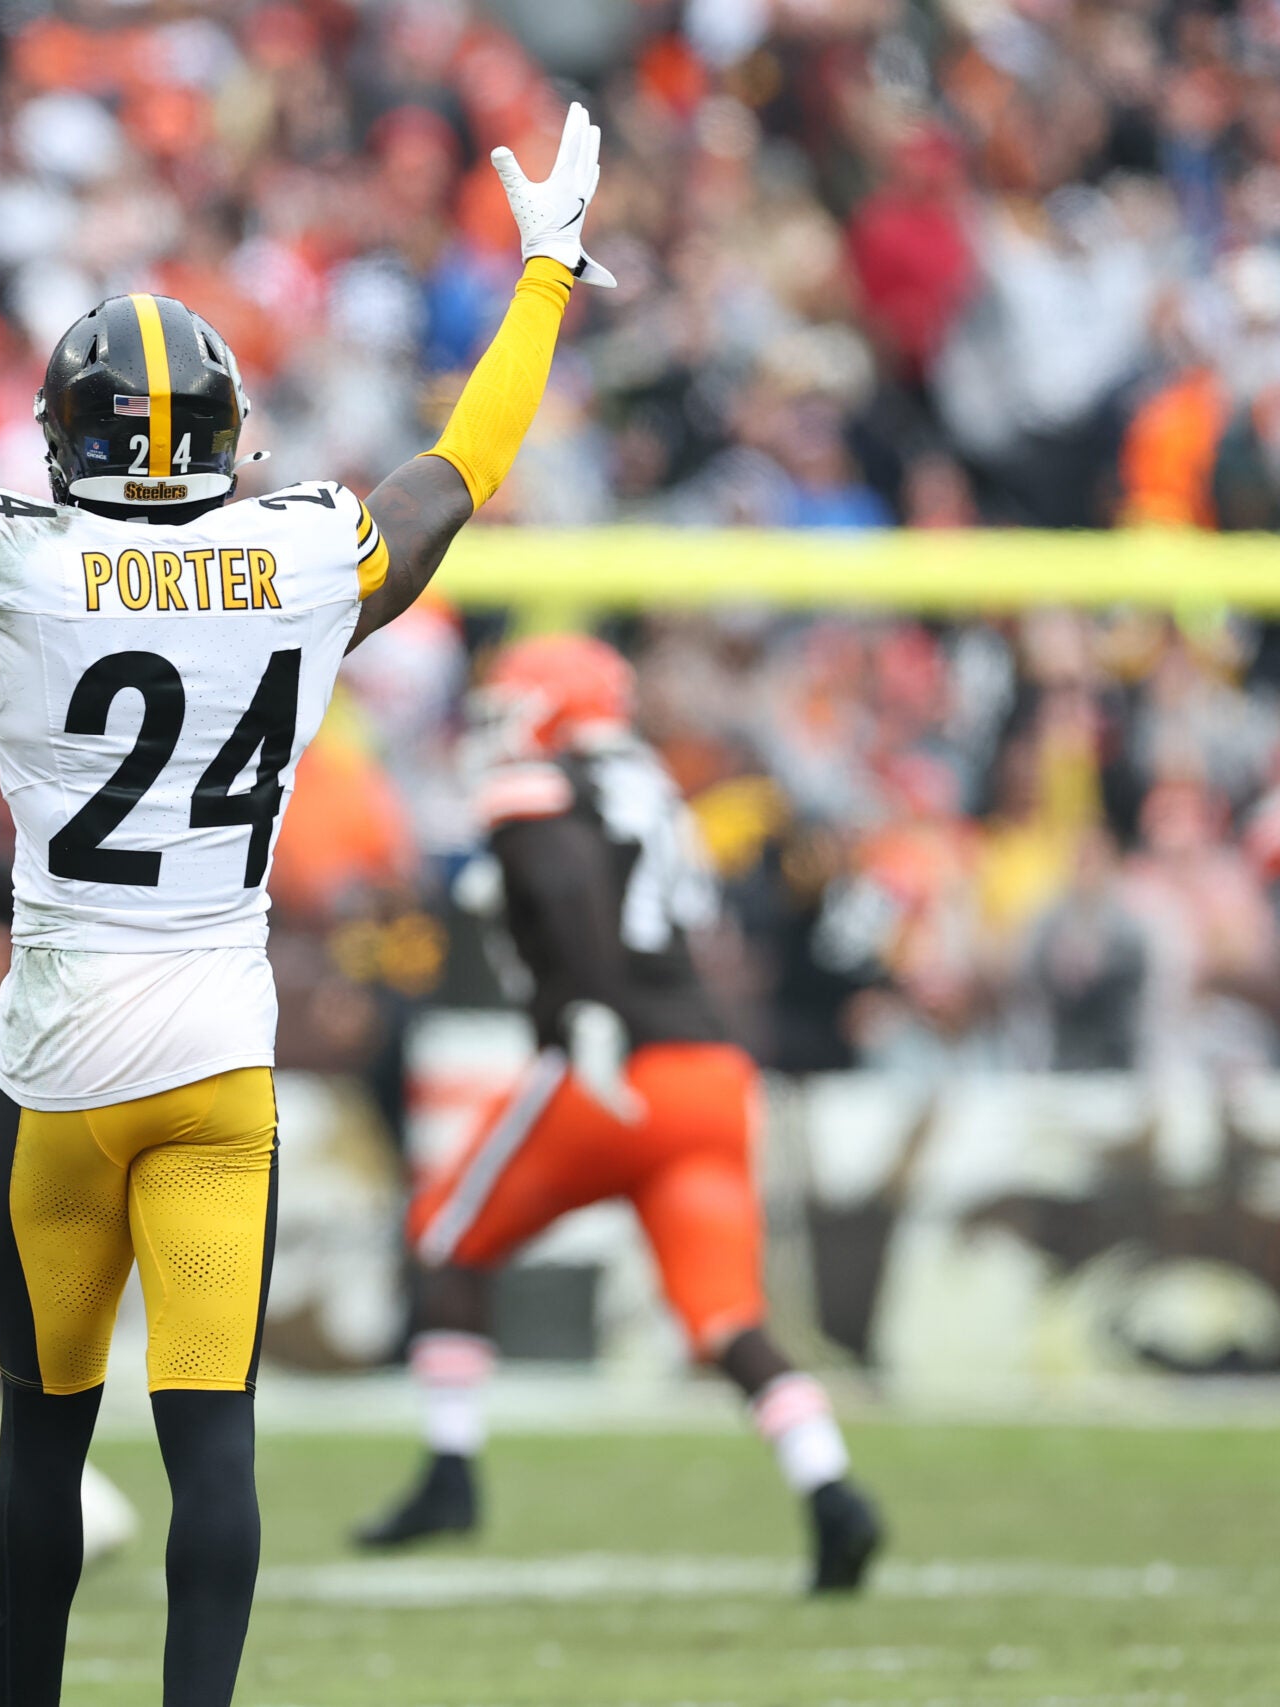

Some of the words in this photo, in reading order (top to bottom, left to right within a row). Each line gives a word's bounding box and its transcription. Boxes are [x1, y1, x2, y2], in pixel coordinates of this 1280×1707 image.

[124, 481, 188, 500] Steelers
[81, 548, 282, 612] PORTER
[48, 647, 302, 888] 24
